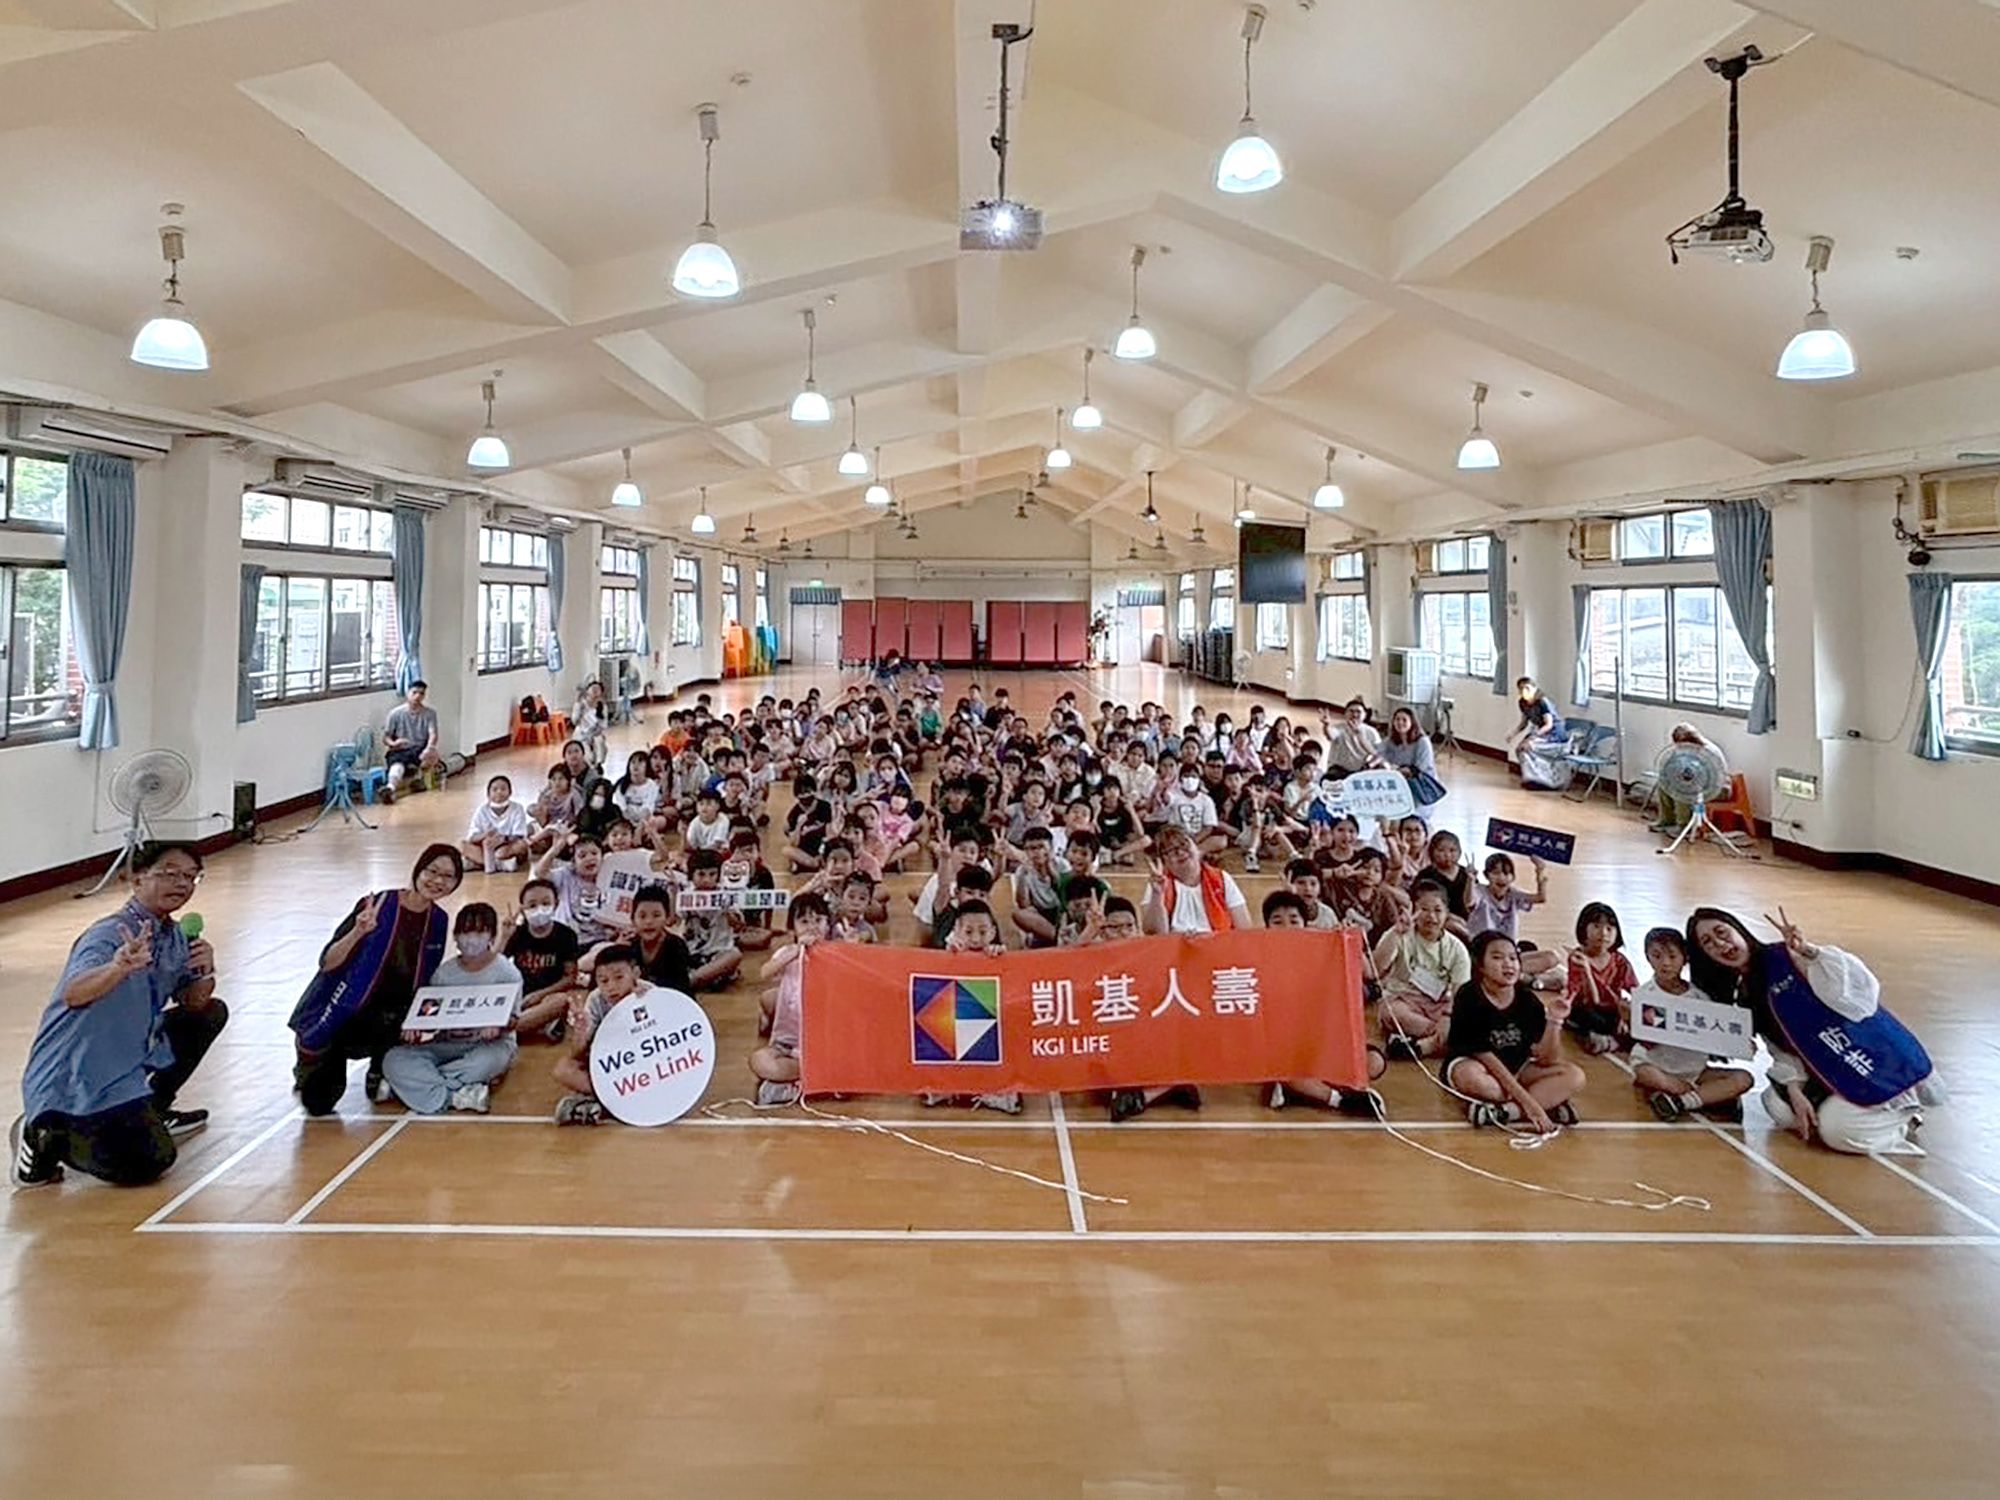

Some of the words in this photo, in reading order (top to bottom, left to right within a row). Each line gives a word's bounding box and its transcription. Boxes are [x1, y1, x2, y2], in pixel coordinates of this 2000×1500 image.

[1031, 966, 1261, 1027] 凱基人壽
[599, 1050, 635, 1074] We
[640, 1022, 703, 1058] Share
[1032, 1037, 1065, 1056] KGI
[1072, 1034, 1111, 1054] LIFE
[1818, 1026, 1875, 1077] 防詐
[613, 1072, 650, 1096] We
[656, 1048, 703, 1080] Link
